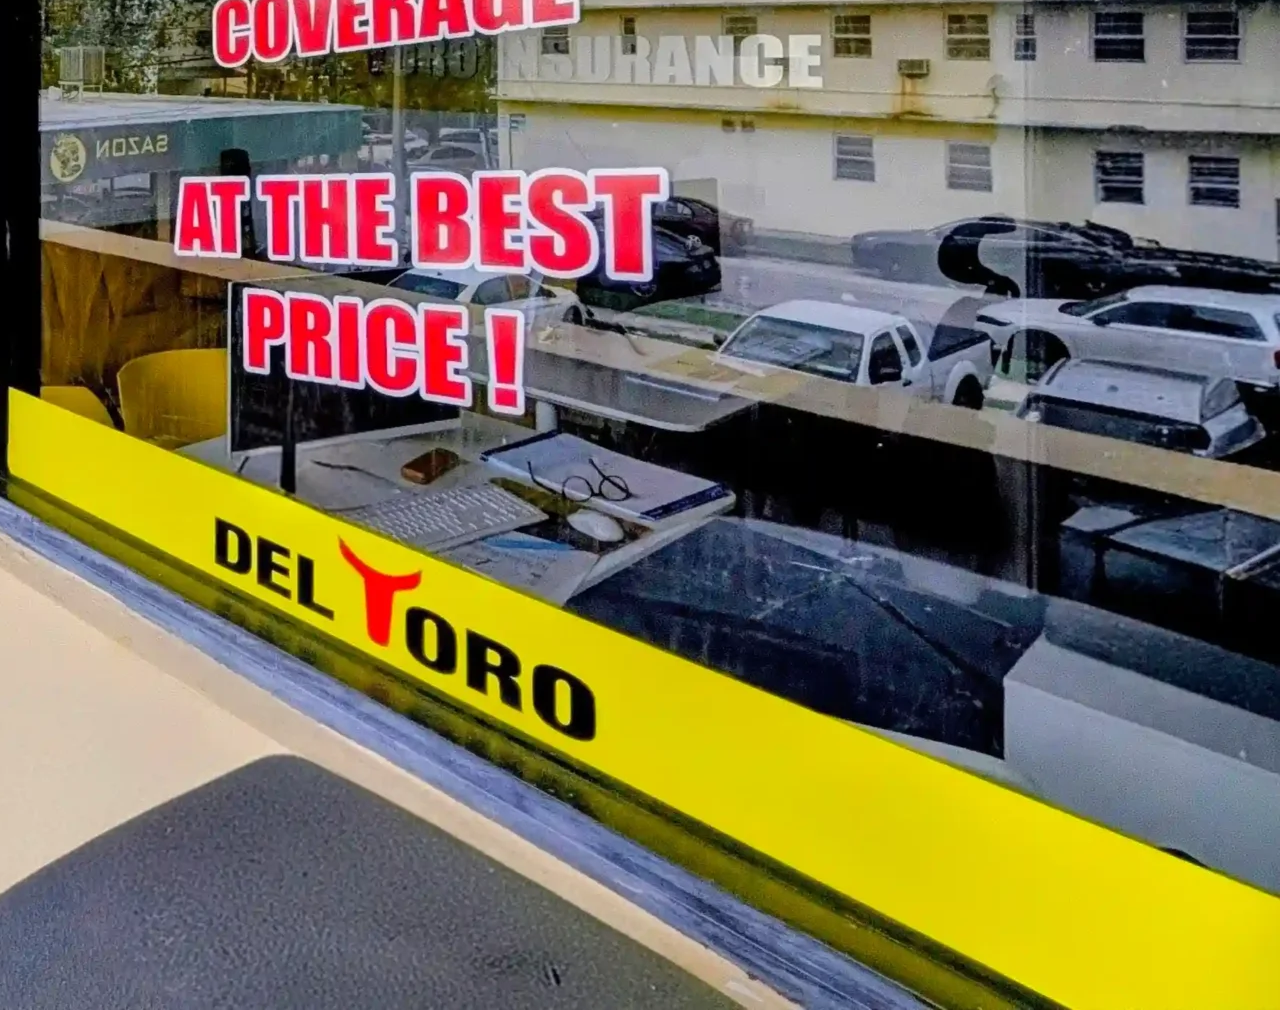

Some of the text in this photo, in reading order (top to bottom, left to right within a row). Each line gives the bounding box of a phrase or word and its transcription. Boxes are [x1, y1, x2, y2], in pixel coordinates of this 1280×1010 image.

[175, 168, 669, 282] AT THE BEST
[243, 287, 472, 407] PRICE
[214, 517, 335, 621] DEL
